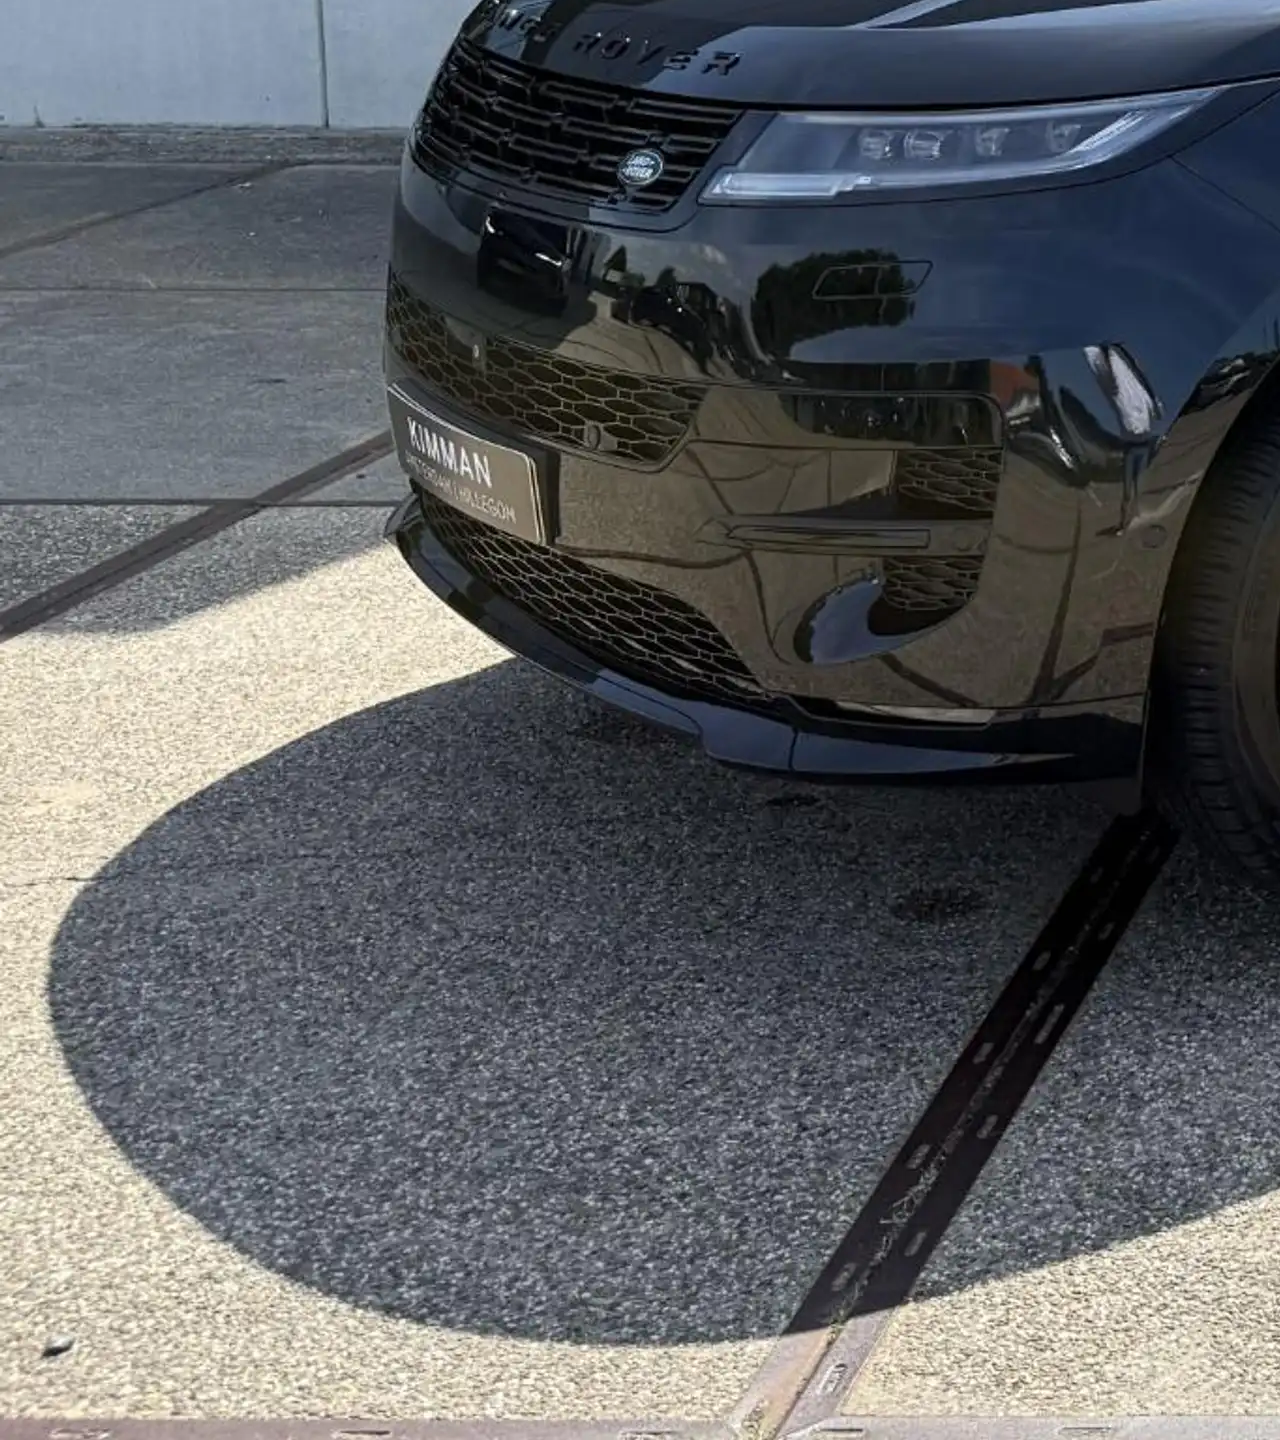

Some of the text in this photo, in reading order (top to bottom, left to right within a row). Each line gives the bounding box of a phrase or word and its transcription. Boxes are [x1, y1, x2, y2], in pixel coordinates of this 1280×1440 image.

[572, 32, 742, 76] ROVER
[407, 416, 492, 489] KIMMAN
[459, 486, 518, 525] HILLEGOM
